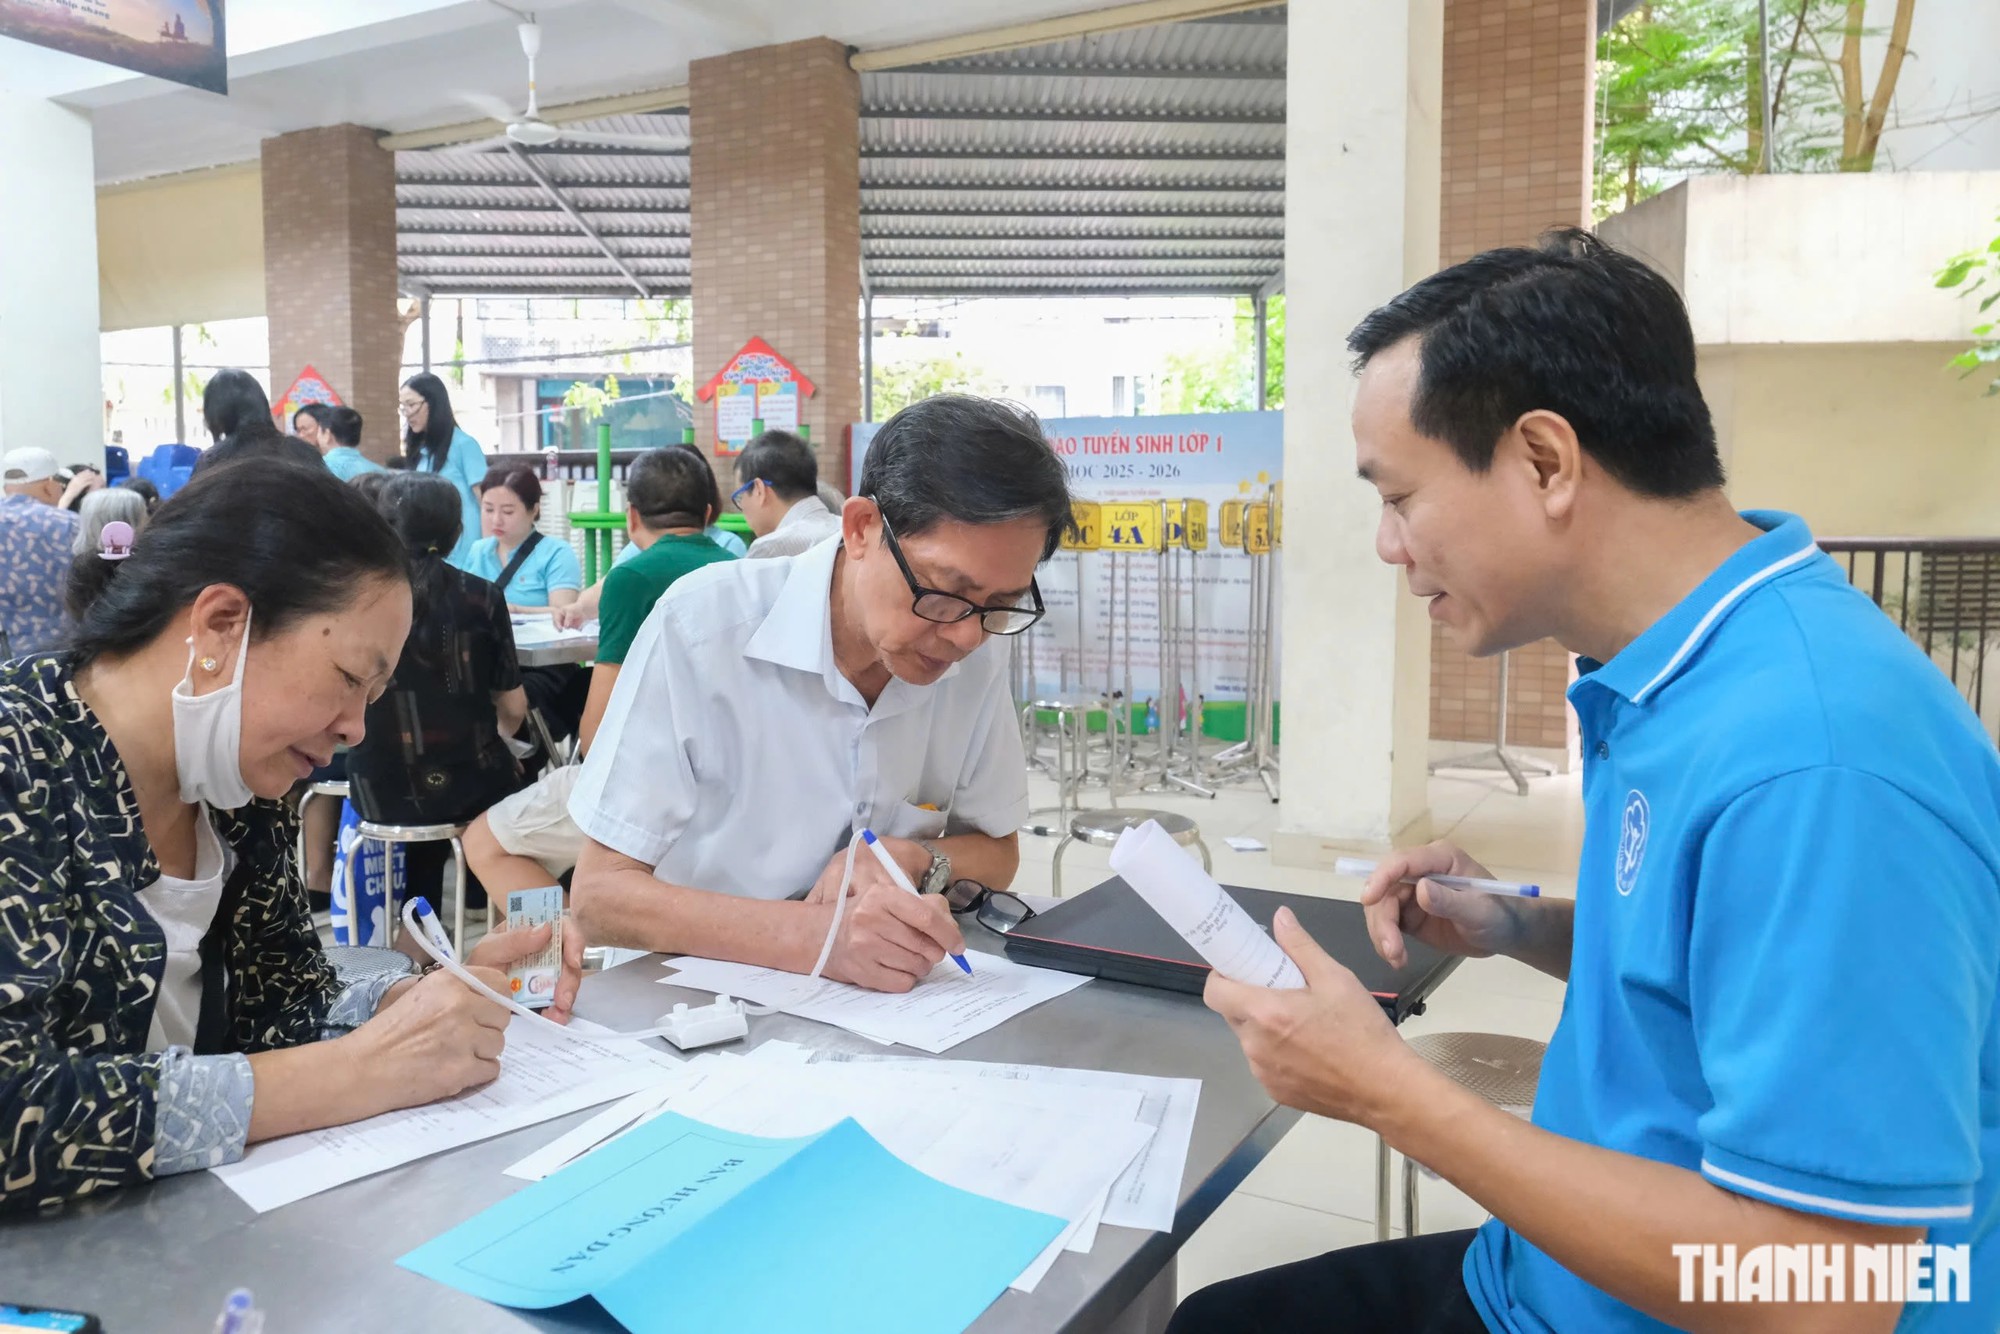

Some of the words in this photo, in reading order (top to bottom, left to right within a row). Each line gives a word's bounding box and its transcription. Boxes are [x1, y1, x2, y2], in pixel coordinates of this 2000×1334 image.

[1082, 429, 1130, 455] TUYỂN
[1136, 434, 1173, 454] SINH
[1179, 431, 1210, 454] LỚP
[1216, 434, 1223, 453] 1
[1103, 464, 1135, 479] 2025
[1149, 463, 1181, 478] 2026
[1114, 508, 1139, 522] LỚP
[1107, 524, 1145, 545] 4A
[364, 852, 406, 876] MET
